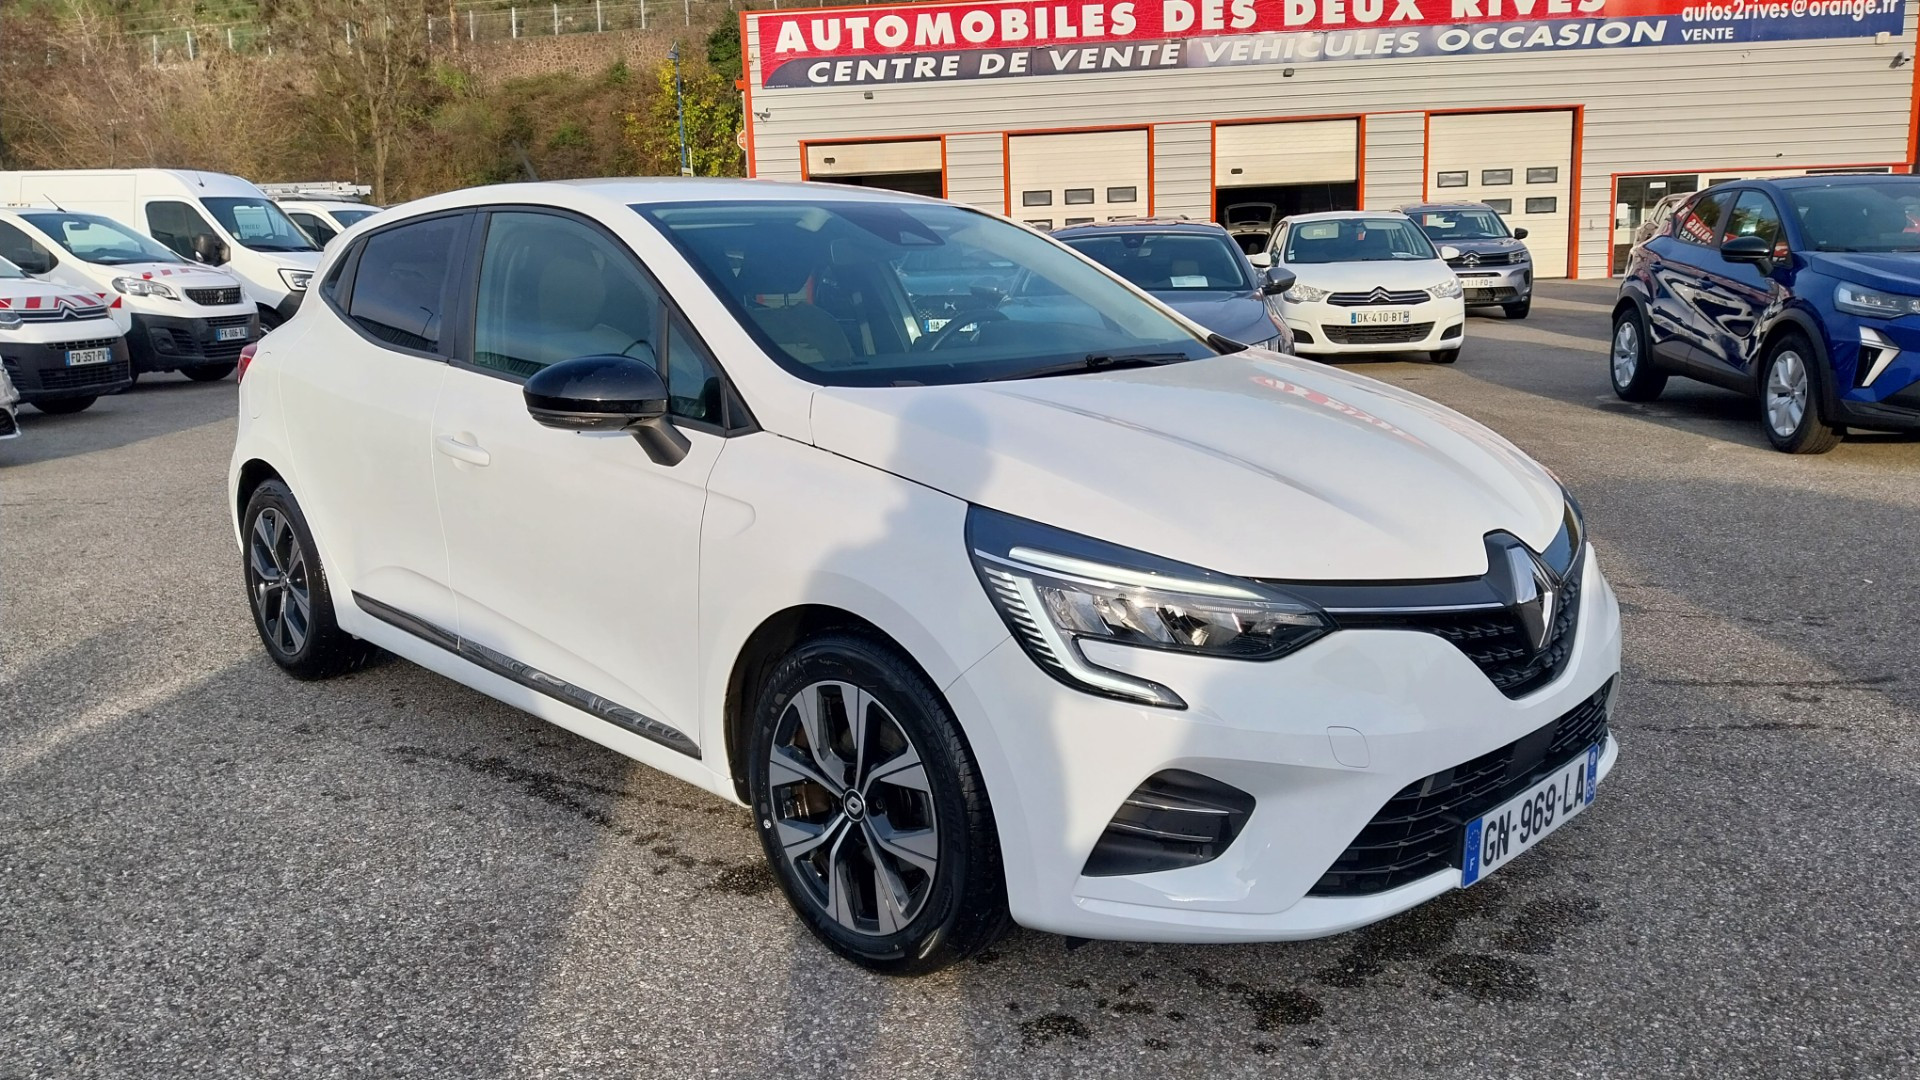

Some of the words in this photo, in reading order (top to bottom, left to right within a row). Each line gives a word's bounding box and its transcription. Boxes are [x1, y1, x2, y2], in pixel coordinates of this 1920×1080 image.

[1682, 0, 1898, 22] autos2rives@orange.fr
[775, 2, 1137, 53] AUTOMOBILES
[1163, 0, 1257, 33] DES
[1284, 0, 1424, 26] DEUX
[1681, 27, 1734, 41] VENTE
[807, 55, 960, 84] CENTRE
[978, 51, 1029, 75] DE
[1049, 43, 1180, 71] VENTE
[1202, 31, 1420, 62] VEHICULES
[1437, 20, 1667, 52] OCCASION
[1357, 312, 1402, 323] DK-410-BT
[1482, 762, 1586, 868] GN-969-LA
[1468, 856, 1476, 872] F
